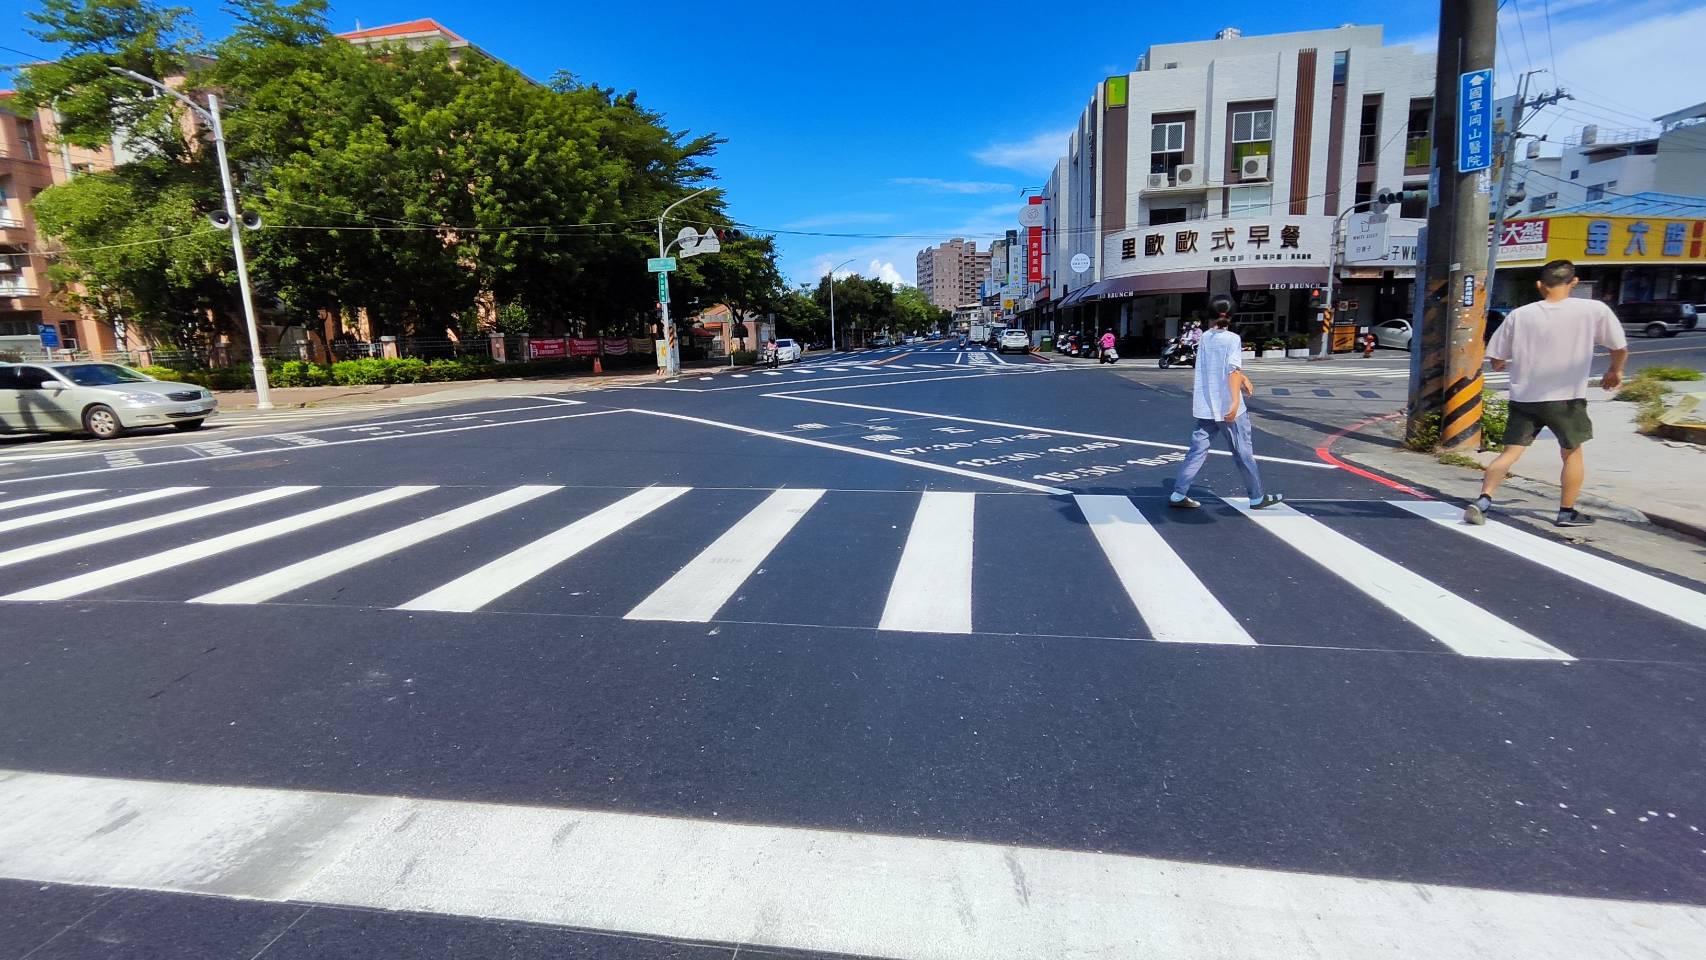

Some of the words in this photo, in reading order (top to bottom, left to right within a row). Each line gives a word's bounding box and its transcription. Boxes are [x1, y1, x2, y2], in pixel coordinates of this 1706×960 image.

[1467, 86, 1483, 168] 國軍岡山醫院
[1121, 224, 1301, 261] 里歐歐式早餐
[1488, 221, 1545, 245] 大盤
